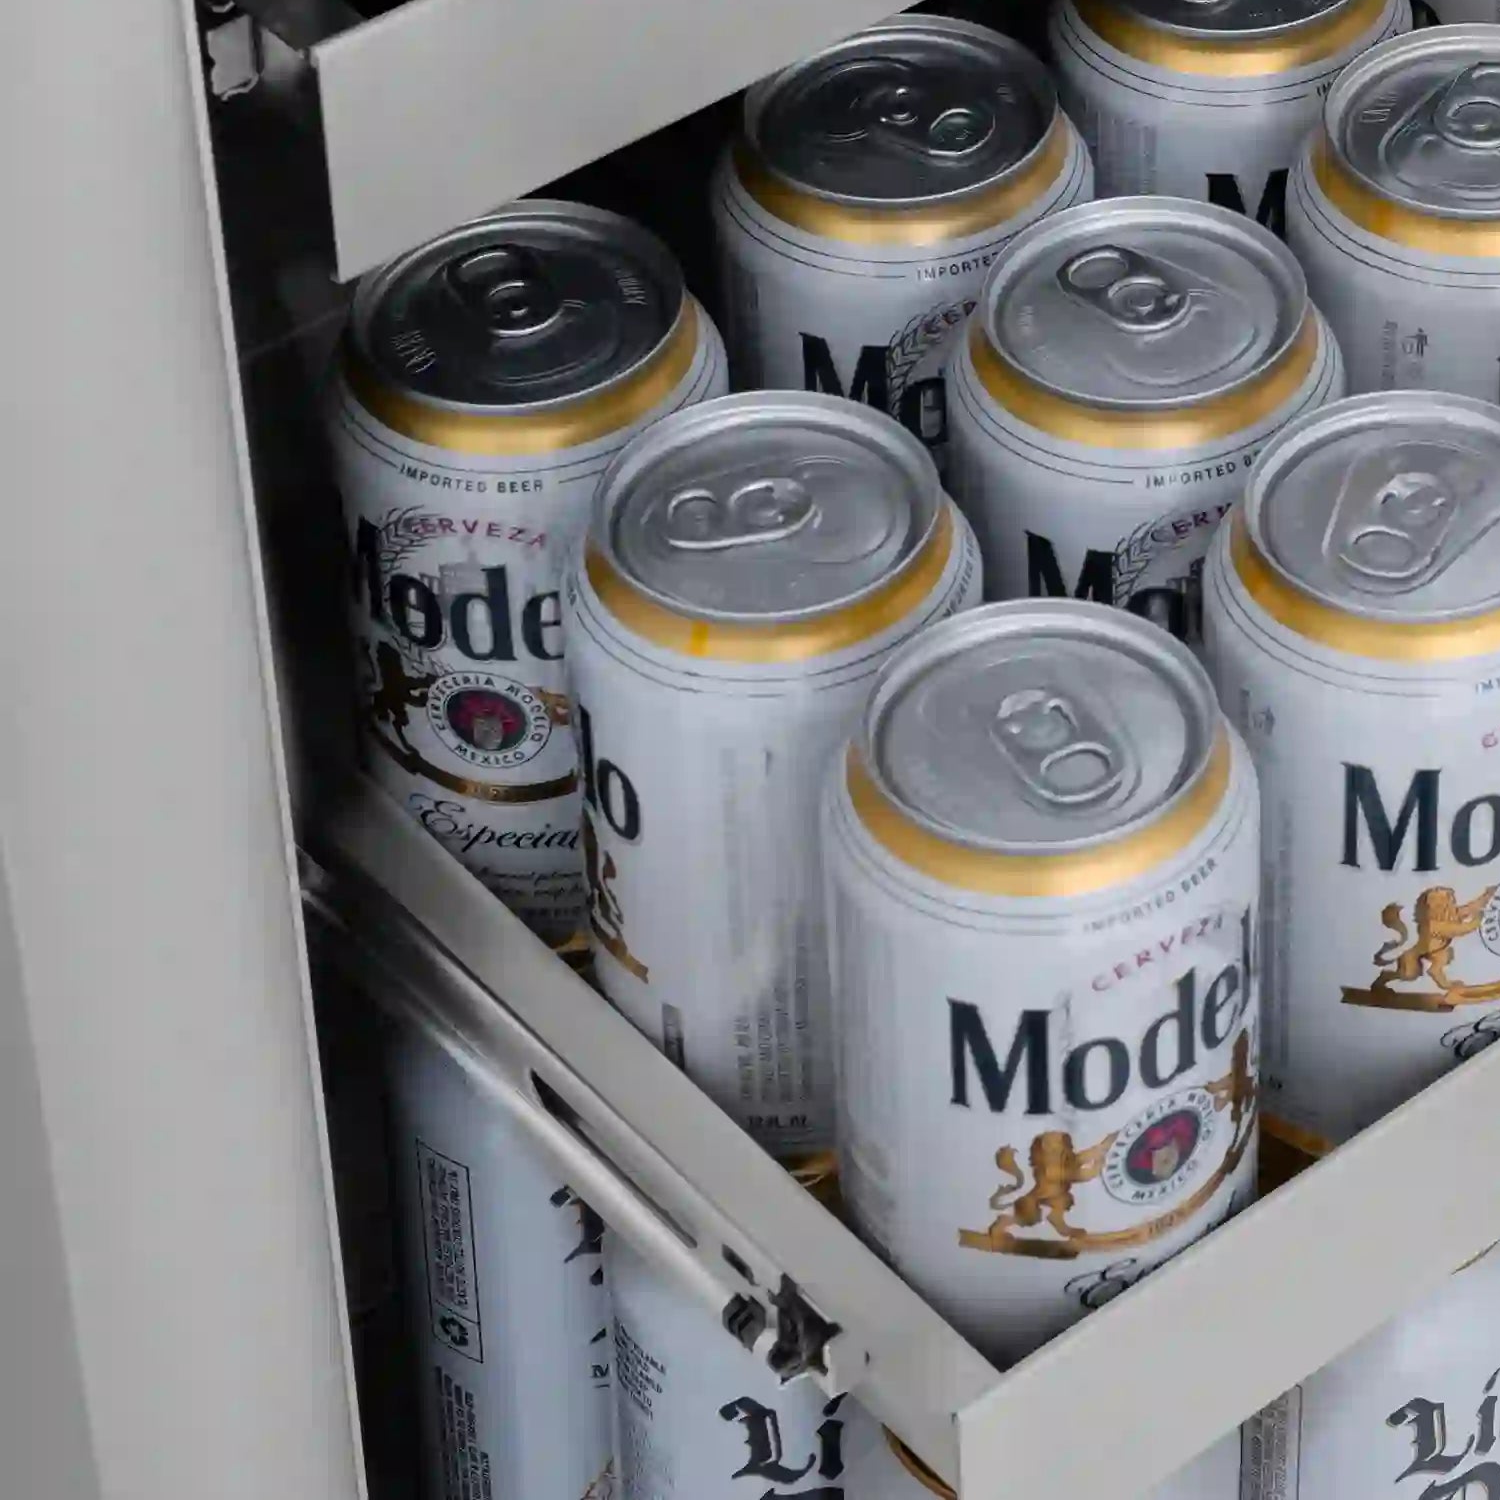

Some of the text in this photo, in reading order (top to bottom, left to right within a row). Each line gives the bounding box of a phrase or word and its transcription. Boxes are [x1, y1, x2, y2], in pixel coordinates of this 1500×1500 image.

[400, 463, 544, 494] IMPORTED BEER
[454, 744, 525, 765] MEXICO
